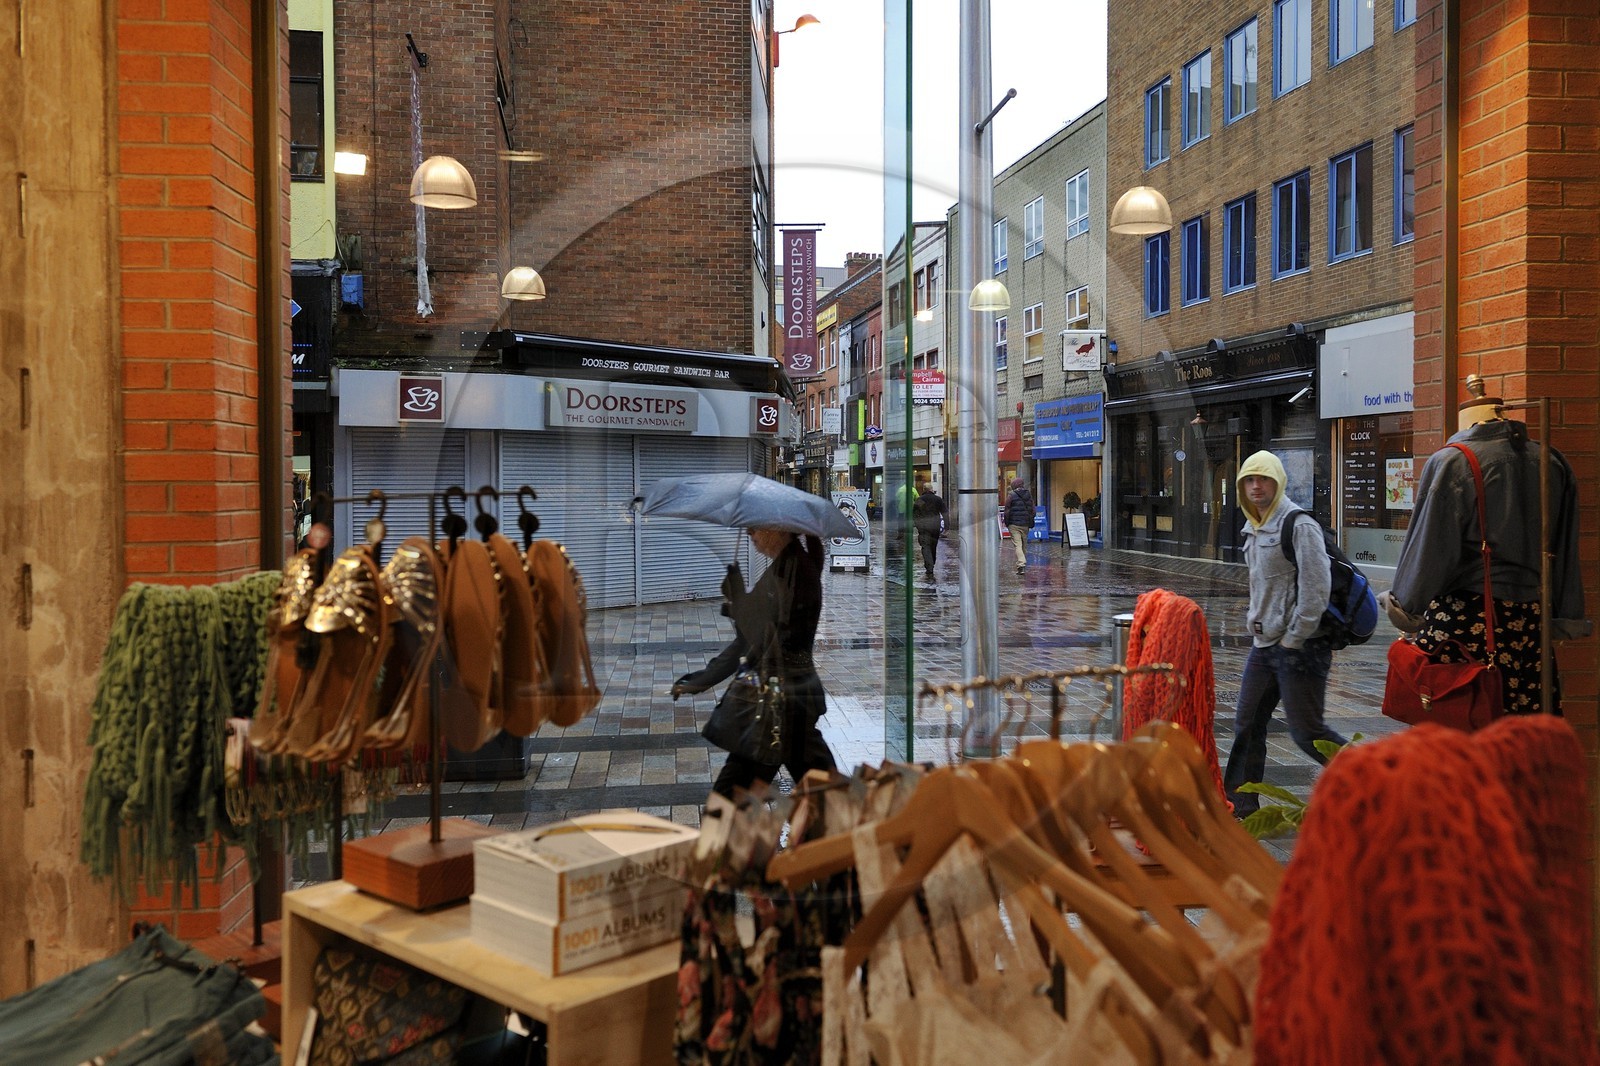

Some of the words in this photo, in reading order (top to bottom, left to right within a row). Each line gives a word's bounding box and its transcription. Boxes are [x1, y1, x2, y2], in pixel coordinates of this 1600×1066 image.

[788, 238, 804, 338] DOORSTEPS
[582, 358, 629, 370] DOORSTEPS
[633, 362, 670, 374] GOURMET
[674, 366, 711, 378] SANDWICH
[714, 370, 730, 378] BAR
[1174, 366, 1191, 382] The
[566, 387, 687, 415] DOORSTEPS
[1364, 394, 1381, 406] food
[1384, 392, 1400, 404] with
[1404, 391, 1413, 402] th
[566, 414, 585, 423] THE
[588, 414, 635, 425] GOURMET
[637, 417, 685, 427] SANDWICH
[1363, 420, 1375, 428] THE
[1350, 432, 1370, 440] CLOCK
[1388, 462, 1402, 470] soup
[1356, 551, 1376, 561] coffee
[570, 874, 604, 896] 1001
[565, 927, 600, 949] 1001
[602, 906, 666, 938] ALBUMS
